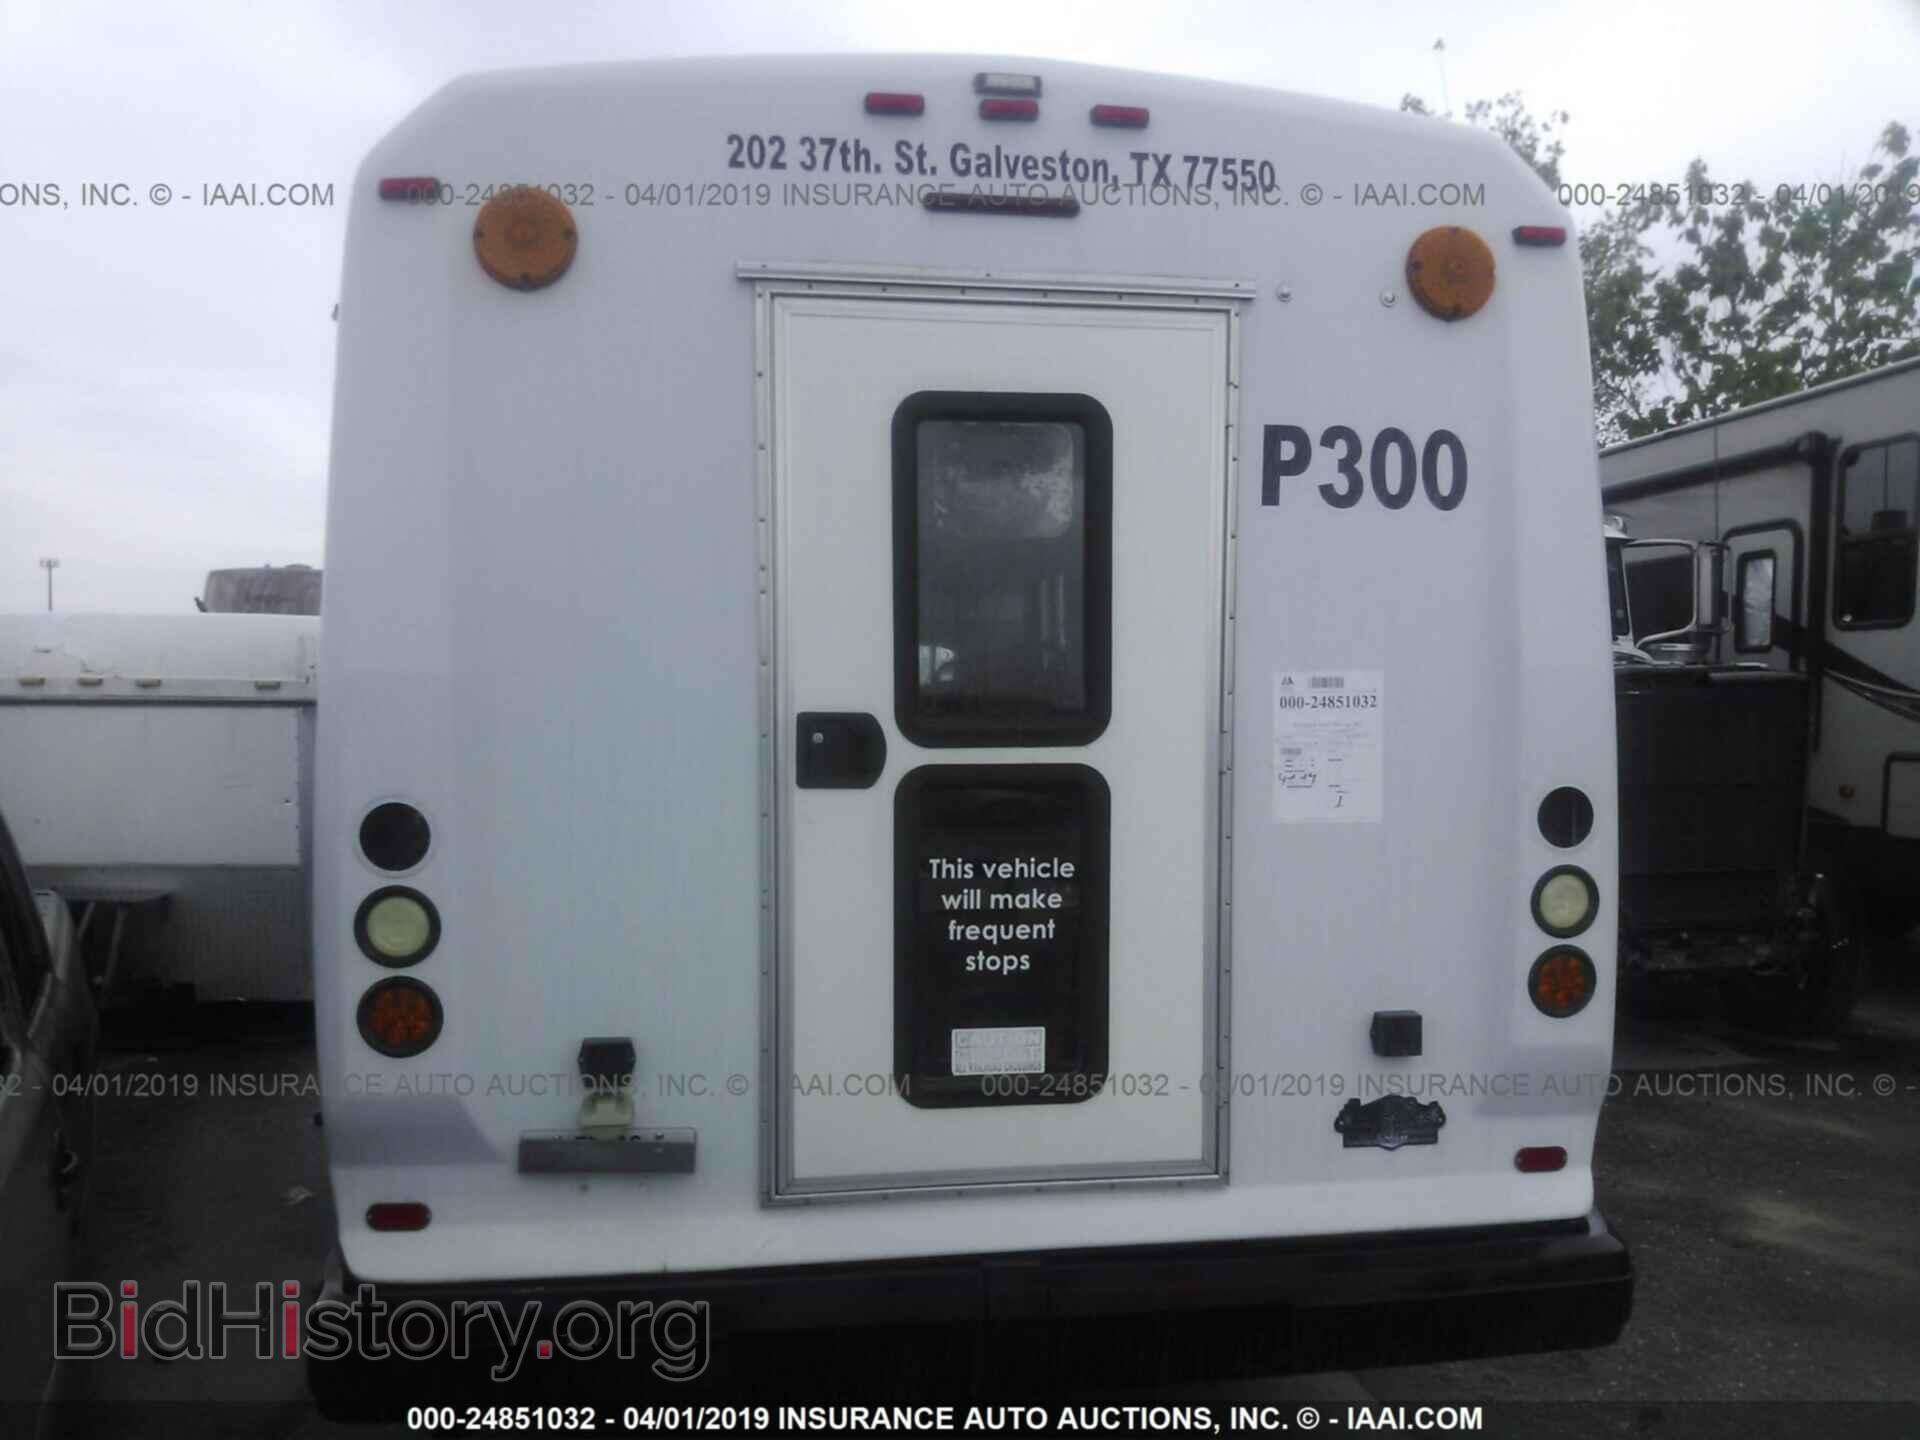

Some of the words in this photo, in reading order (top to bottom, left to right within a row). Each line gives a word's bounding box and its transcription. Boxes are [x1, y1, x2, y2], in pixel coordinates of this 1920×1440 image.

[727, 134, 787, 170] 202
[799, 136, 882, 174] 37th.
[895, 139, 937, 176] St.
[949, 142, 1119, 192] Galveston,
[1129, 152, 1172, 187] TX
[1182, 155, 1276, 193] 77550
[1261, 424, 1468, 511] P300
[1279, 695, 1377, 709] 000-24851032
[929, 858, 974, 879] This
[982, 857, 1075, 879] vehicle
[941, 888, 981, 910] will
[990, 888, 1063, 909] make
[948, 918, 1056, 945] frequent
[965, 950, 1030, 975] stops
